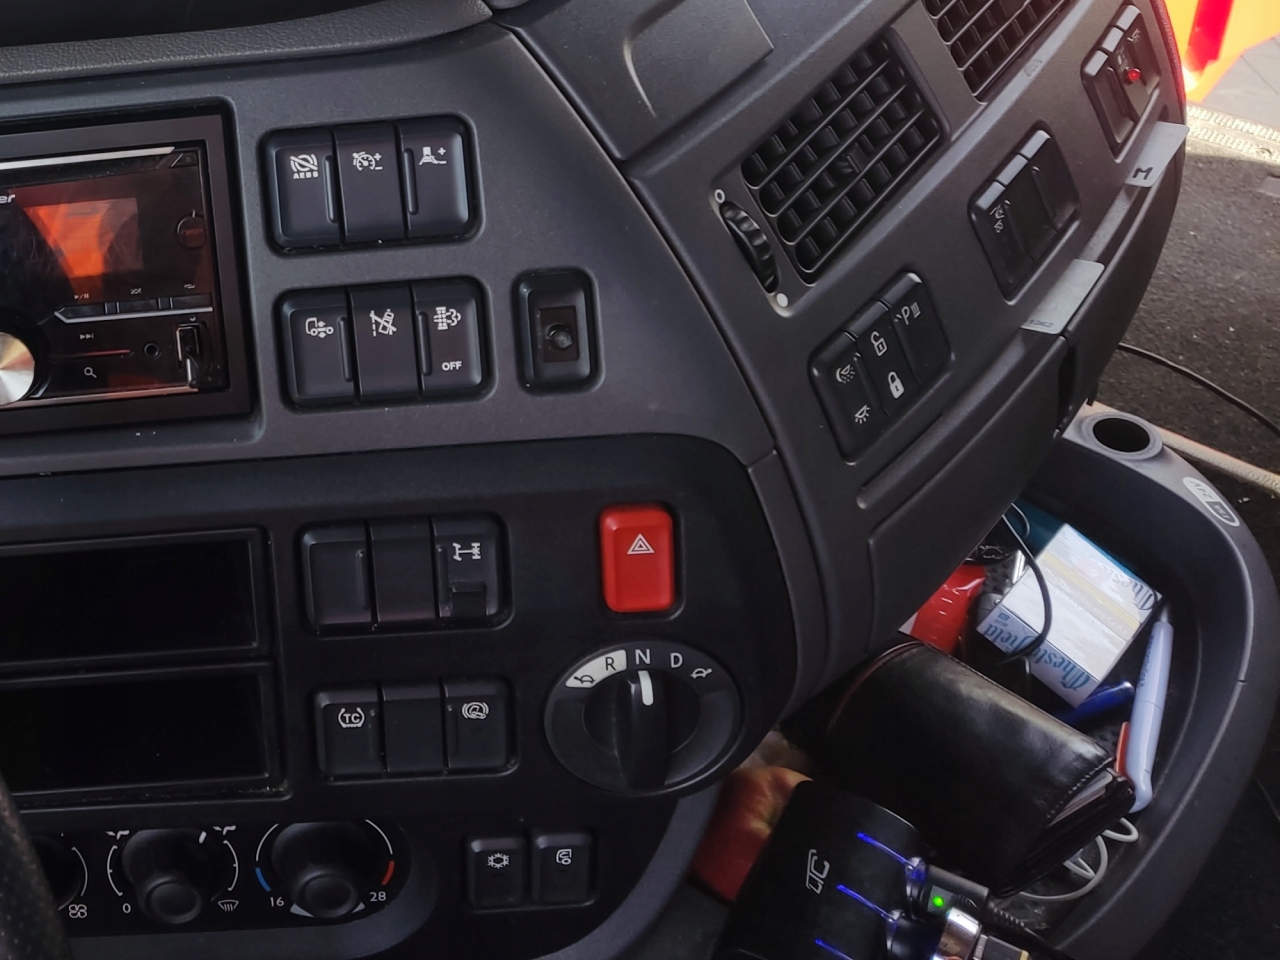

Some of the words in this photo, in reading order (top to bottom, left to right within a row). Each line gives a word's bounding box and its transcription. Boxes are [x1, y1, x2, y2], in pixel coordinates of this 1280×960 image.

[441, 361, 463, 371] OFF
[635, 649, 651, 665] N
[671, 653, 683, 668] D
[983, 623, 1092, 691] Chestfield
[605, 657, 617, 671] R
[270, 897, 284, 908] 16
[370, 891, 387, 902] 28
[122, 903, 131, 914] 0
